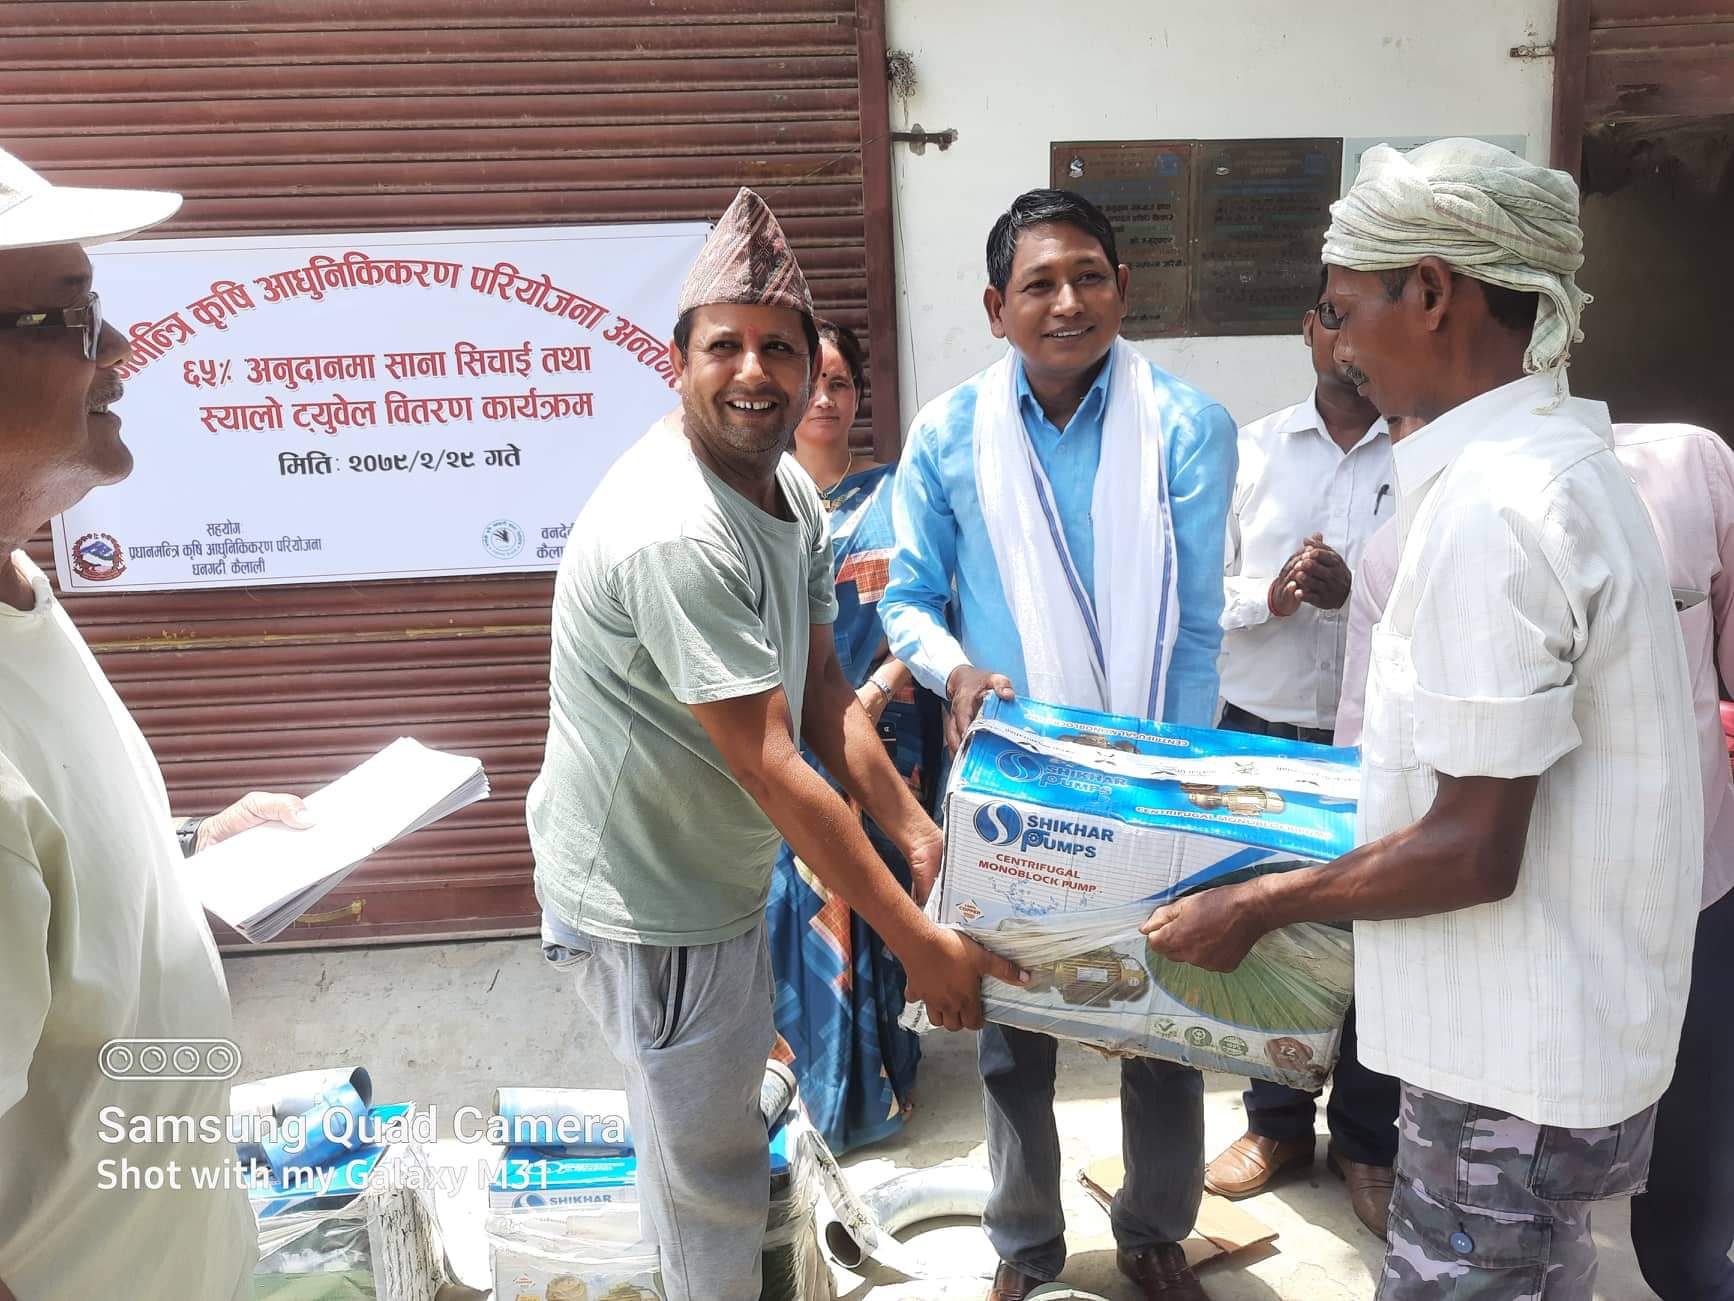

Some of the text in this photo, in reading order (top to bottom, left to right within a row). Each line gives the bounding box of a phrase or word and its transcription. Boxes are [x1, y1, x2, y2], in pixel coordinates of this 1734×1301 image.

[186, 280, 256, 330] कृषि
[253, 251, 463, 301] आधुनिकिकरण
[471, 262, 610, 330] परियोजना
[183, 341, 591, 389] ६५% अनुदानमा साना सिचाई तथा
[199, 396, 283, 433] स्यालो
[384, 390, 473, 424] वितरण
[481, 387, 594, 420] कार्यक्रम
[349, 449, 475, 473] २०७९/२/२९
[484, 443, 521, 467] गते
[206, 519, 241, 537] सहयोग
[182, 540, 203, 560] कृषि
[276, 535, 322, 553] परियोजना
[231, 557, 265, 574] कैलाली
[1039, 773, 1113, 795] PUMPS
[1047, 766, 1128, 786] SHIKHAR
[1026, 815, 1114, 842] SHIKHAR
[1021, 828, 1097, 858] PUMPS
[979, 860, 1097, 893] MONOBLOCK PUMP
[996, 853, 1080, 879] CENTRIFUGAL
[550, 1194, 612, 1206] SHIKHAR
